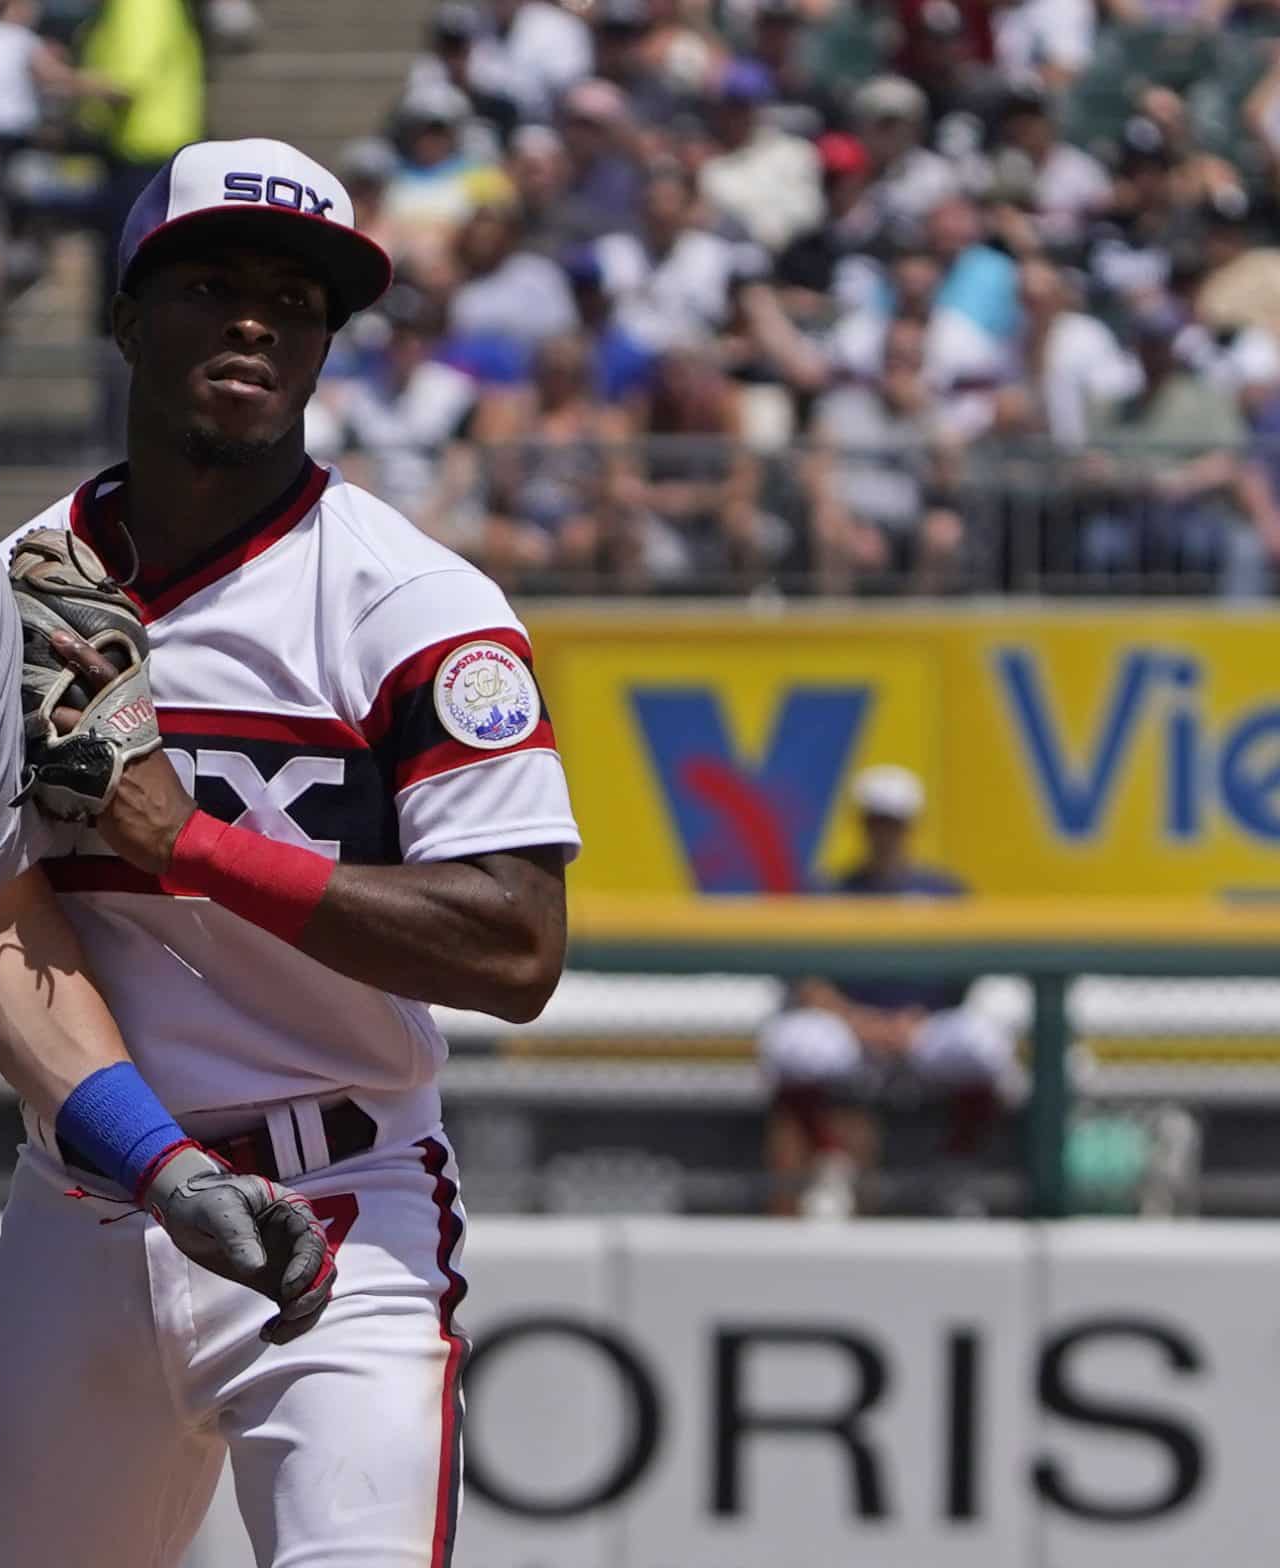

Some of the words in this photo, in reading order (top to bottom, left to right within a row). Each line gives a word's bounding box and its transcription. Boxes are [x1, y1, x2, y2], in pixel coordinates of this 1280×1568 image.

[223, 171, 334, 218] SOX
[485, 650, 516, 671] GAME
[462, 1316, 1208, 1524] ORIS
